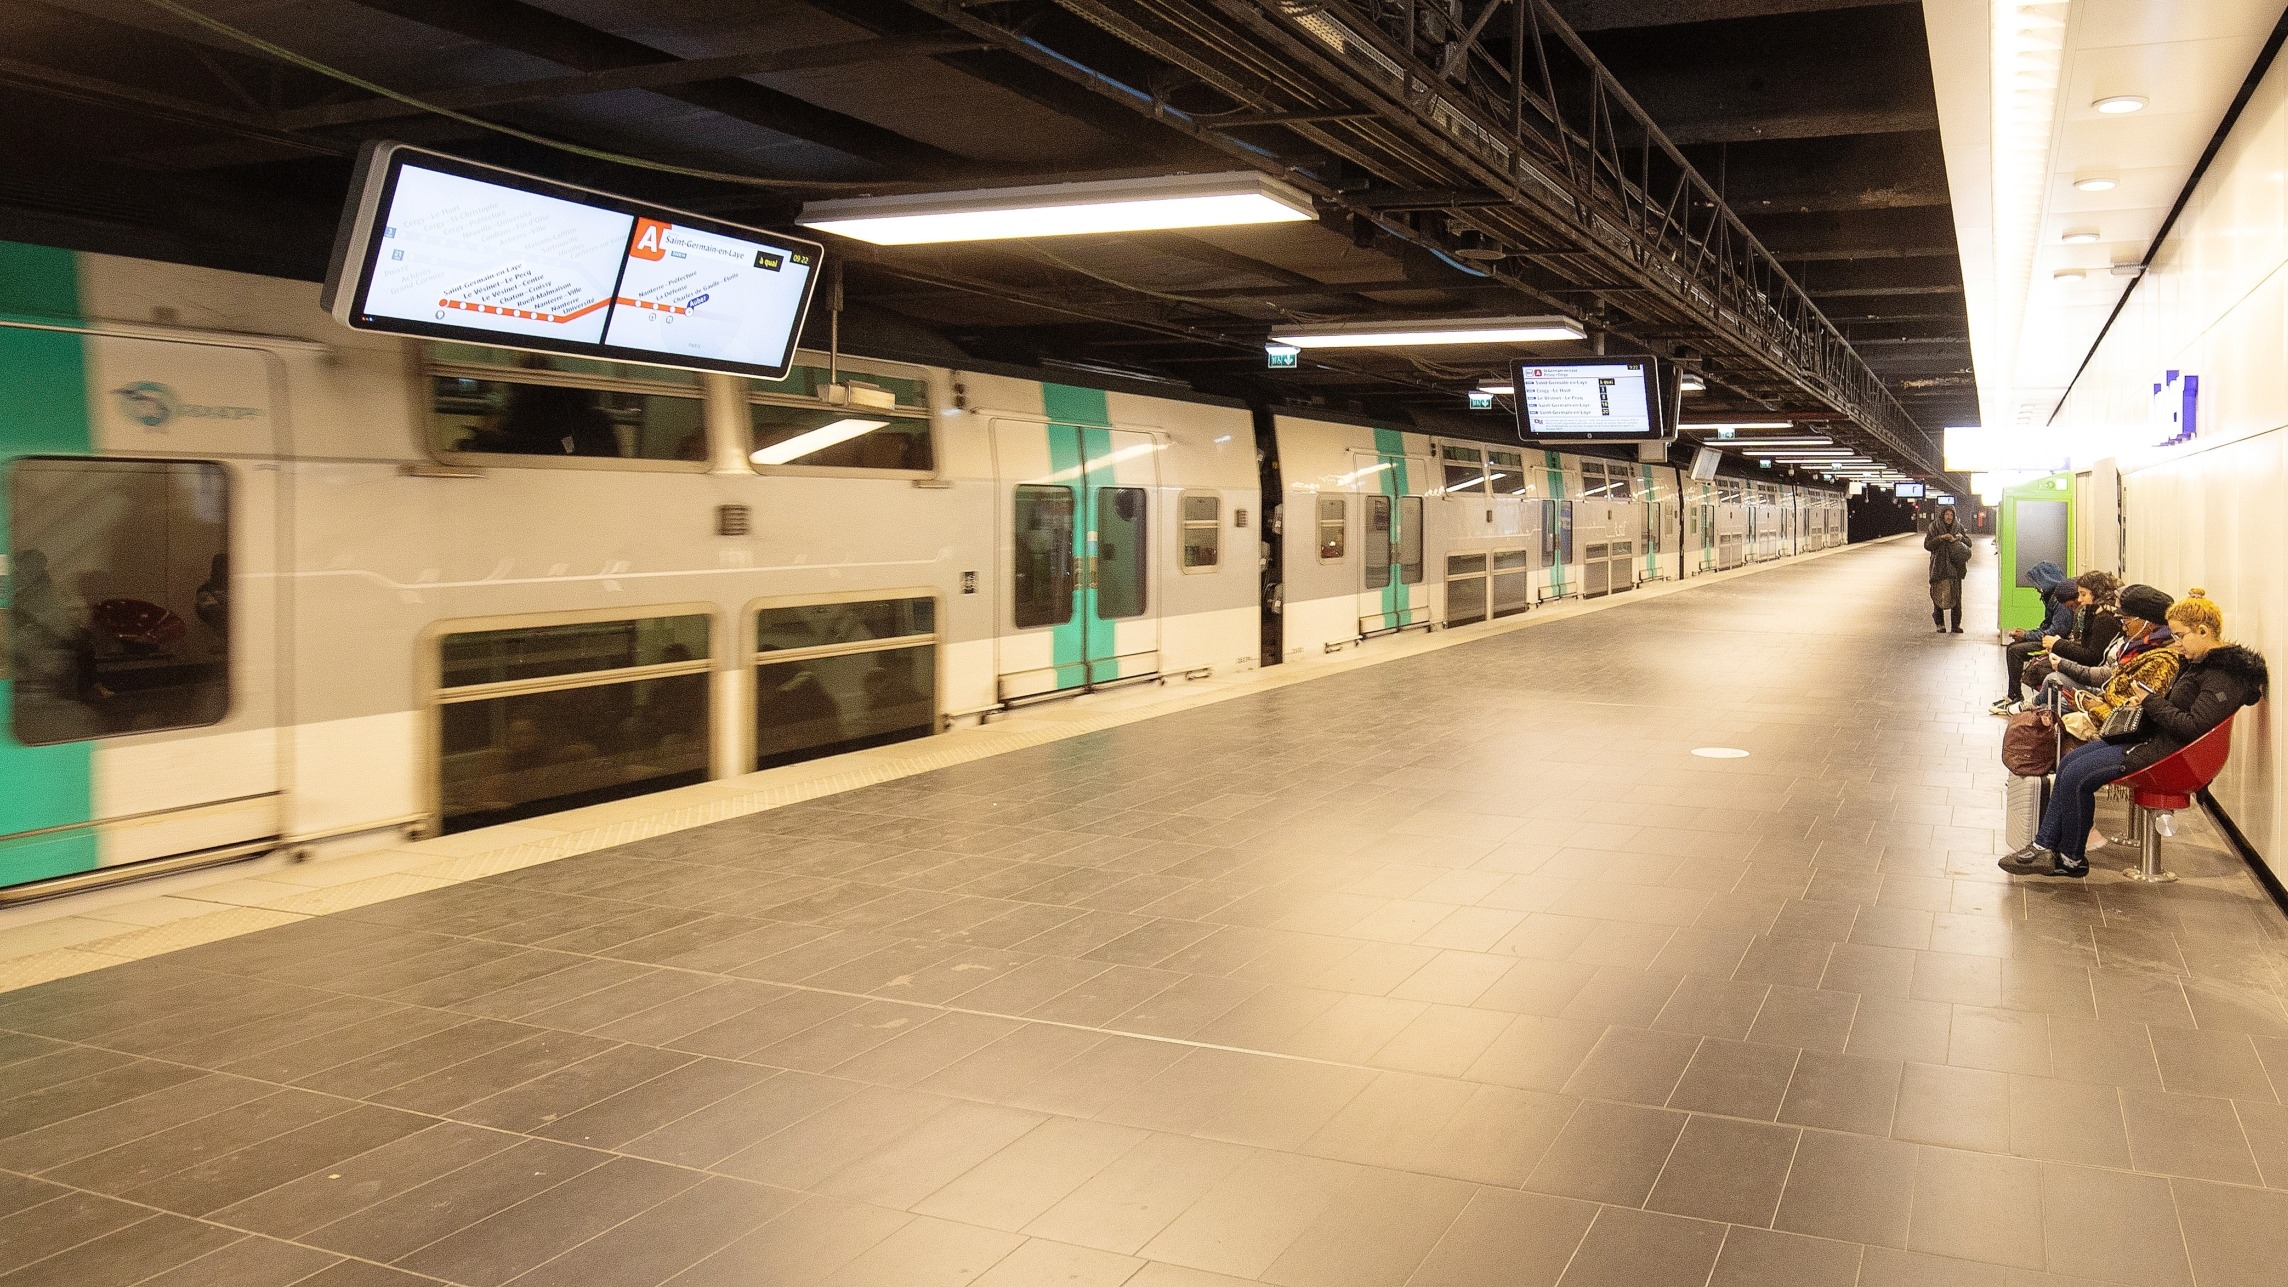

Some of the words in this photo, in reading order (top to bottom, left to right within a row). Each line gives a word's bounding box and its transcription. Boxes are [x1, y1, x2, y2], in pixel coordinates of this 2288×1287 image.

[636, 226, 658, 253] A
[665, 235, 744, 260] Saint-Germain-en-Laye
[764, 259, 778, 268] quai
[444, 263, 522, 296] Saint-Germain-en-Laye
[463, 290, 472, 299] Le
[474, 280, 500, 294] Vésinet
[505, 275, 514, 284] Le
[515, 270, 532, 281] Pecq
[482, 293, 491, 302] Le
[492, 284, 518, 298] Vésinet
[523, 274, 544, 286] Centre
[638, 284, 664, 297] Nanterre
[668, 270, 697, 286] Préfecture
[664, 285, 687, 298] Défense
[673, 291, 693, 304] Charles
[703, 279, 720, 292] Gaulle
[500, 292, 524, 305] Chatou
[529, 280, 552, 293] Croissy
[517, 282, 571, 307] Rueil-Malmaison
[534, 296, 563, 309] Nanterre
[568, 286, 582, 297] Ville
[551, 298, 579, 312] Nanterre
[690, 295, 706, 306] Auber
[562, 297, 595, 314] Université
